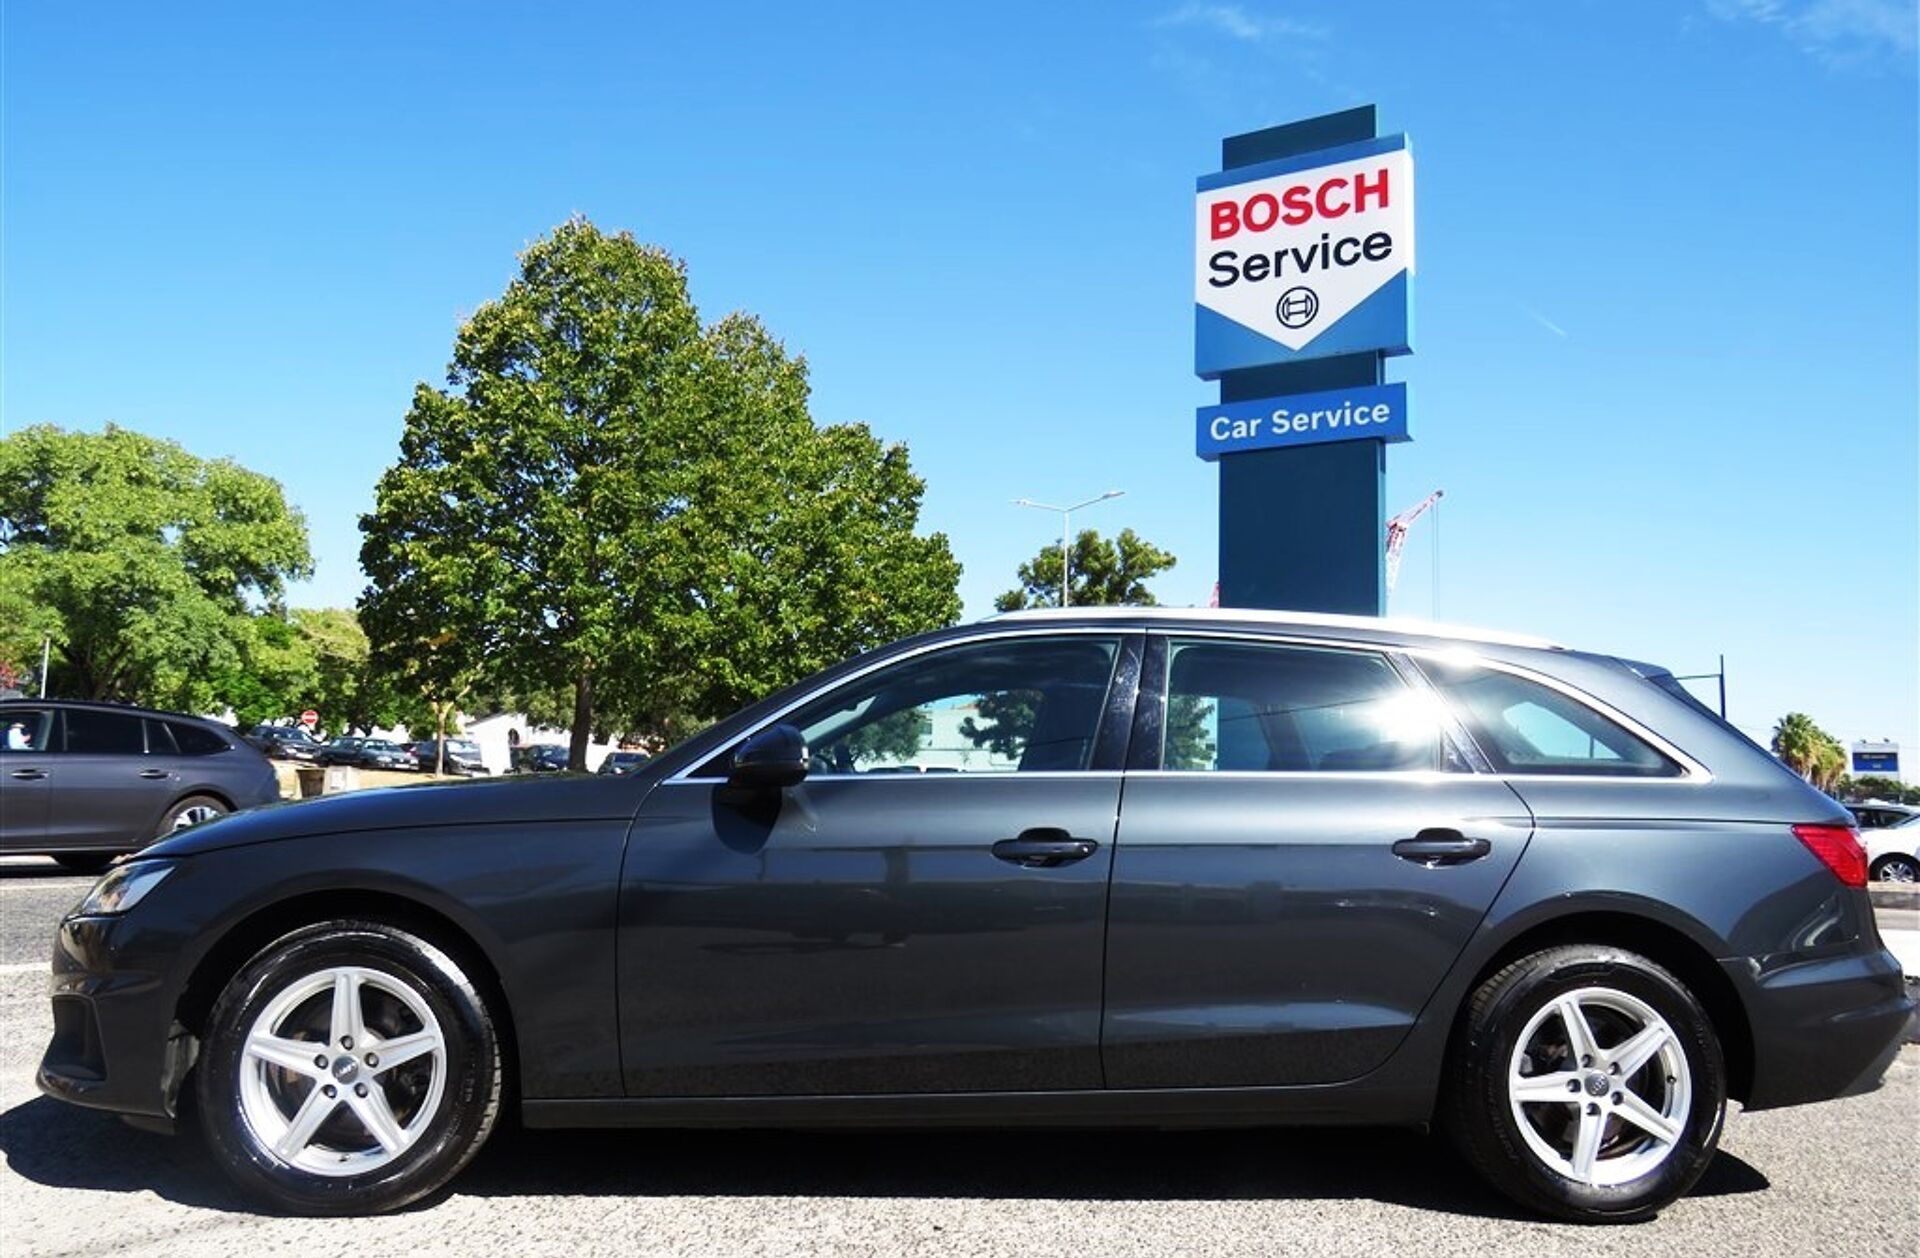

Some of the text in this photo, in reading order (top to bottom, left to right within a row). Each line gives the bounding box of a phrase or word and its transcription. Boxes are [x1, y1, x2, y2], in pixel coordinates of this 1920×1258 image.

[1211, 168, 1389, 240] BOSCH
[1208, 232, 1391, 287] Service
[1210, 402, 1390, 441] Car Service
